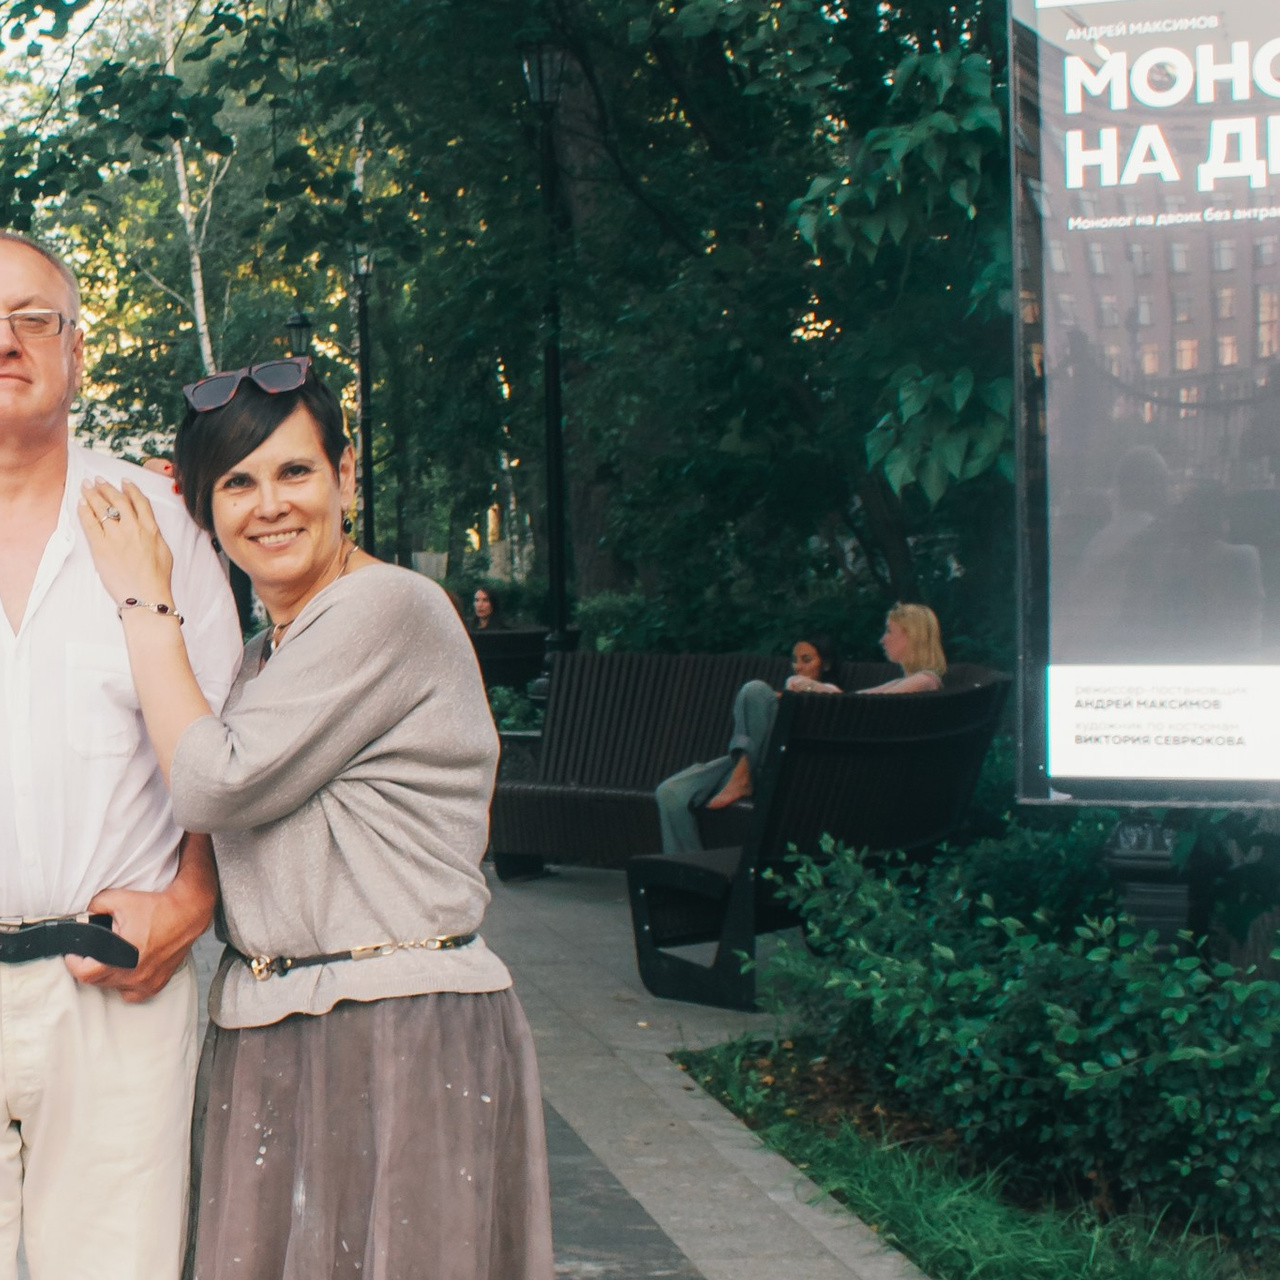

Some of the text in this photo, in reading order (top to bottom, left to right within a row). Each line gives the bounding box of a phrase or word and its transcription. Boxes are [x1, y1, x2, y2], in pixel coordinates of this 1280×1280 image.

[1066, 15, 1219, 42] АНДРЕЙ МАКСИМОВ
[1065, 115, 1280, 192] НА Д
[1067, 216, 1132, 231] Монолог
[1203, 207, 1230, 222] без
[1074, 697, 1222, 710] АНДРЕЙ МАКСИМОВ
[1074, 734, 1247, 747] ВИКТОРИЯ СЕВРЮКОВА
